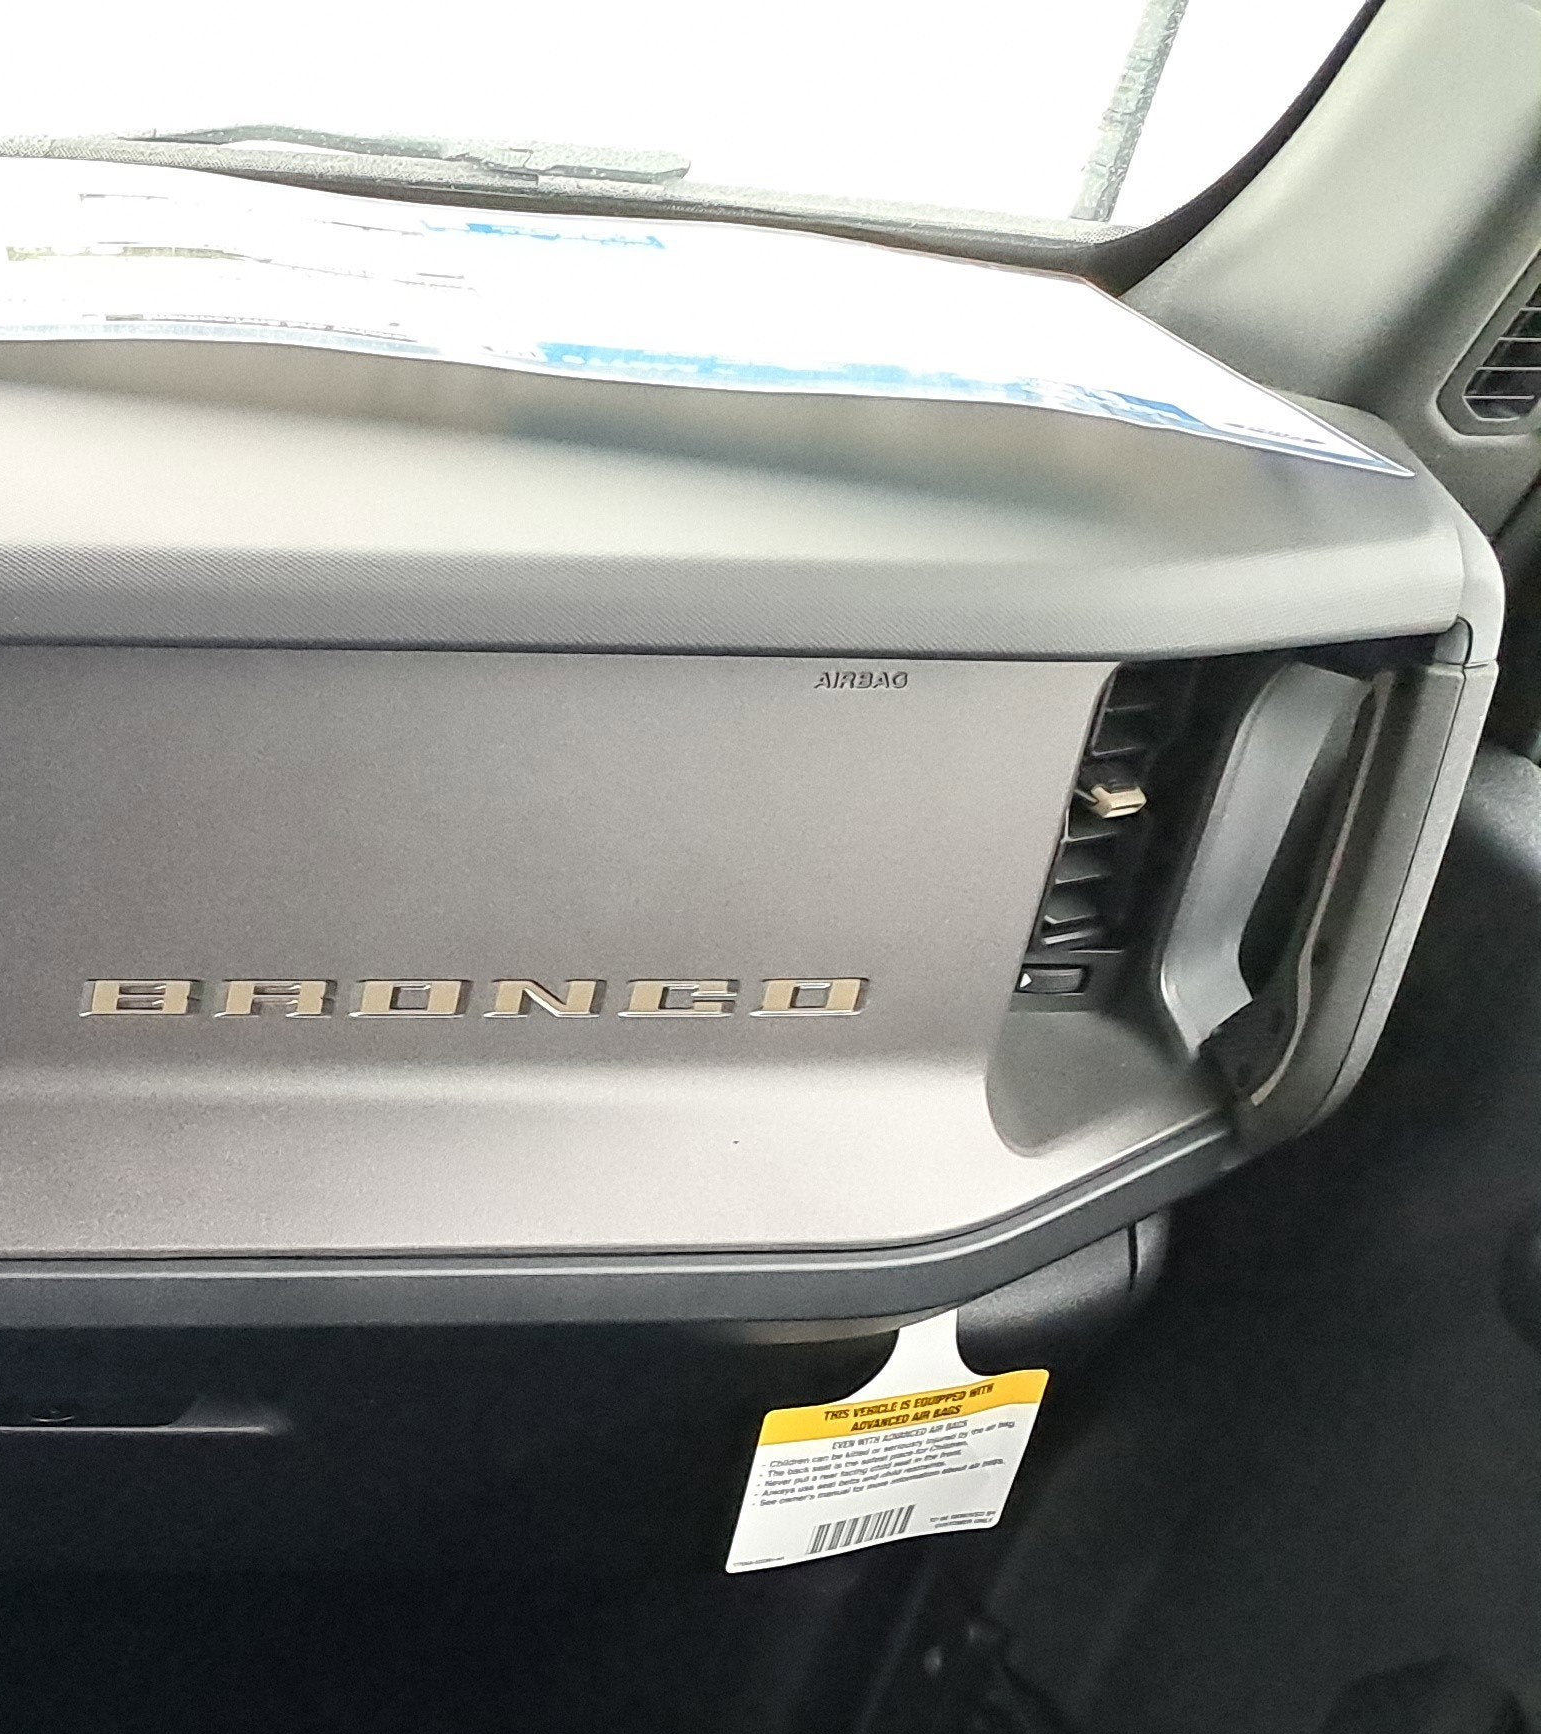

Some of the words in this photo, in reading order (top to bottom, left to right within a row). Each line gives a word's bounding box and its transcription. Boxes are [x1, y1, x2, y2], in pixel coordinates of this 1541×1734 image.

[814, 671, 909, 689] AIRBAG
[79, 977, 868, 1019] BRONCO
[824, 1410, 849, 1421] THIS
[853, 1402, 897, 1418] VEHICLE
[900, 1400, 911, 1410] IS
[913, 1391, 966, 1408] EQUIPPED
[969, 1383, 995, 1398] WITH
[851, 1414, 909, 1431] ADVANCED
[911, 1410, 931, 1422] AIR
[933, 1405, 963, 1418] BAGS
[882, 1428, 927, 1442] ADVANCED
[929, 1425, 944, 1433] AIR
